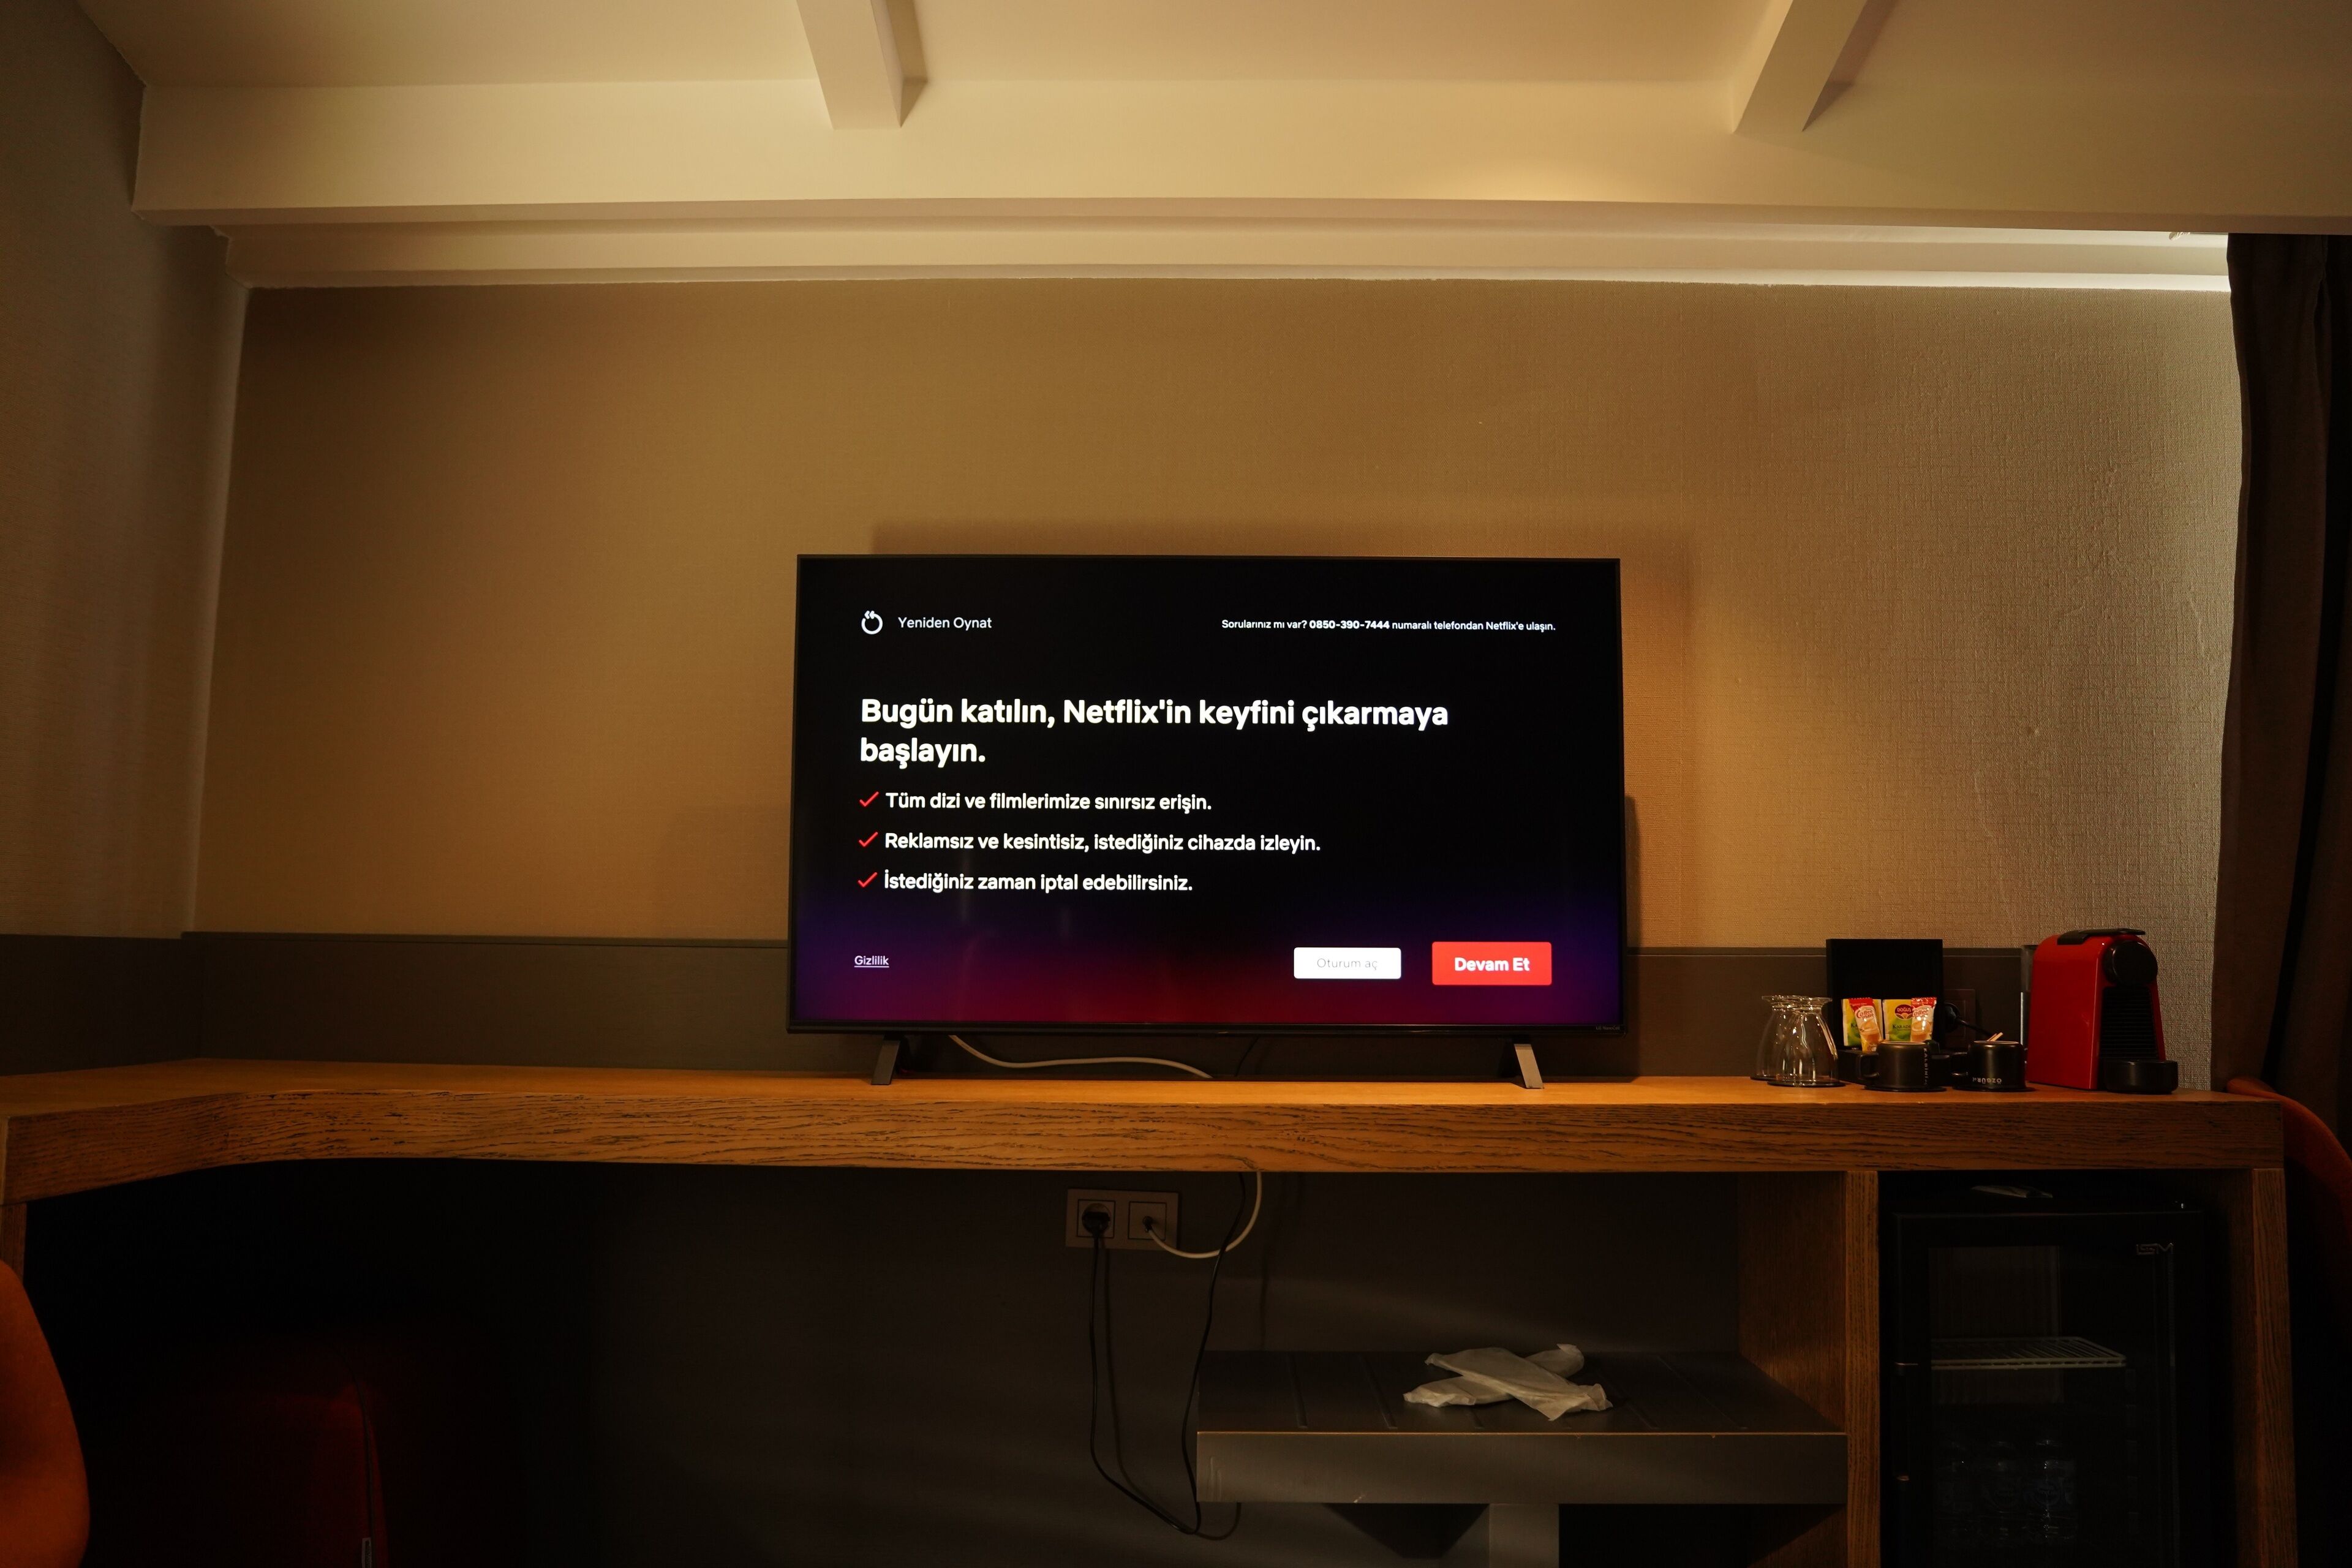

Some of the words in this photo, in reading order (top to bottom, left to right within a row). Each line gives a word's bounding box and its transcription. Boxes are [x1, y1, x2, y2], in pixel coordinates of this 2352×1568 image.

[898, 617, 950, 628] Yeniden
[953, 617, 992, 631] Oynat
[1221, 619, 1272, 628] Sorularınız
[1286, 620, 1308, 629] var?
[1309, 620, 1390, 629] 0850-390-7444
[1392, 620, 1432, 630] numaralı
[1433, 620, 1484, 630] telefondan
[1485, 621, 1525, 630] Netflix'e
[1526, 621, 1556, 633] ulaşın.
[861, 698, 953, 729] Bugün
[961, 698, 1055, 728] katılın,
[1063, 698, 1191, 724] Netflix'in
[1199, 699, 1295, 730] keyfini
[1302, 700, 1448, 732] çıkarmaya
[860, 737, 986, 769] başlayın.
[885, 792, 925, 809] Tüm
[930, 792, 960, 809] dizi
[964, 796, 986, 809] ve
[989, 792, 1091, 810] filmlerimize
[1095, 797, 1156, 810] sınırsız
[1159, 794, 1212, 815] erişin.
[885, 832, 974, 849] Reklamsız
[978, 836, 999, 850] ve
[1003, 832, 1090, 853] kesintisiz,
[1094, 833, 1184, 854] istediğiniz
[1188, 834, 1256, 851] cihazda
[1260, 834, 1321, 854] izleyin.
[884, 870, 974, 894] İstediğiniz
[978, 876, 1036, 890] zaman
[1041, 873, 1078, 894] iptal
[1082, 873, 1193, 891] edebilirsiniz.
[854, 955, 889, 966] Gizlilik
[1317, 958, 1361, 968] Oturum
[1365, 960, 1378, 971] aç
[1454, 957, 1509, 971] Devam
[1512, 957, 1530, 971] Et
[1856, 1009, 1873, 1018] Coffee
